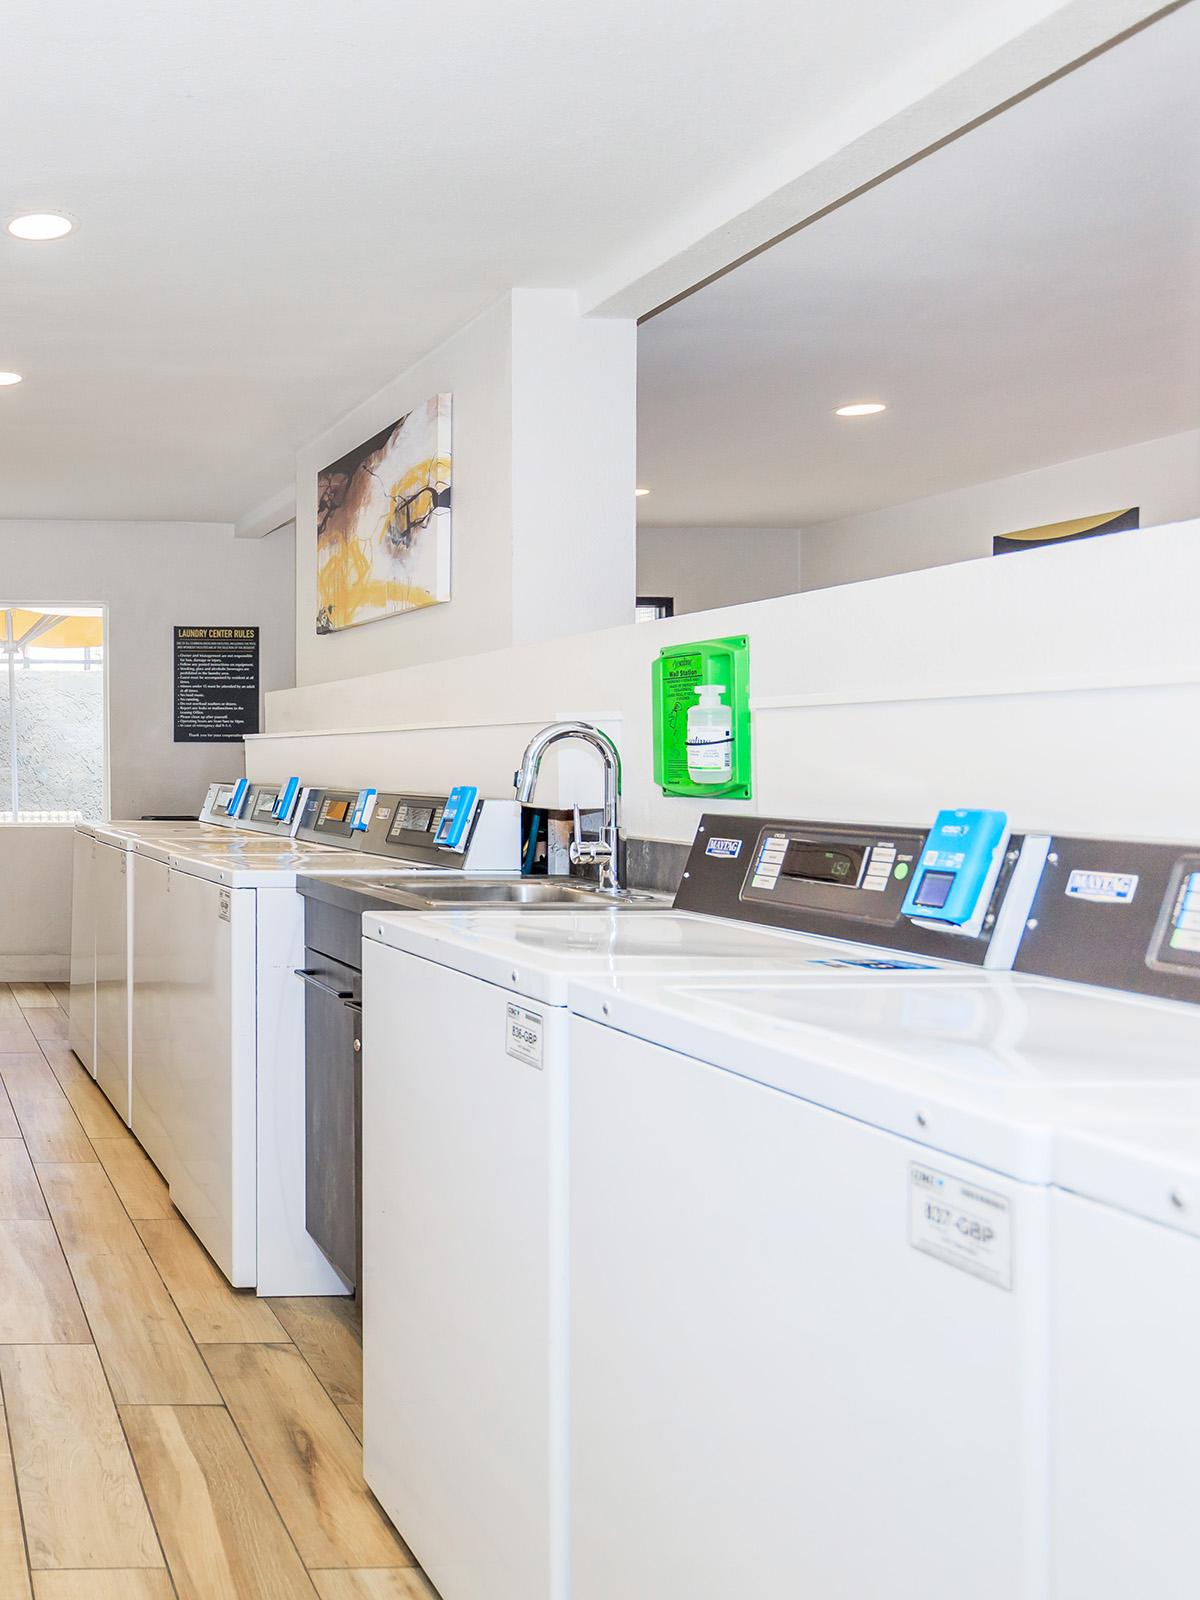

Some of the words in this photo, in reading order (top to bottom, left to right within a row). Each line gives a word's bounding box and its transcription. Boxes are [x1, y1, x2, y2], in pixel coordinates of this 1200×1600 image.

[178, 629, 207, 638] LAUNDRY
[208, 629, 233, 638] CENTER
[234, 630, 255, 638] RULES
[709, 839, 738, 851] MAYTAG
